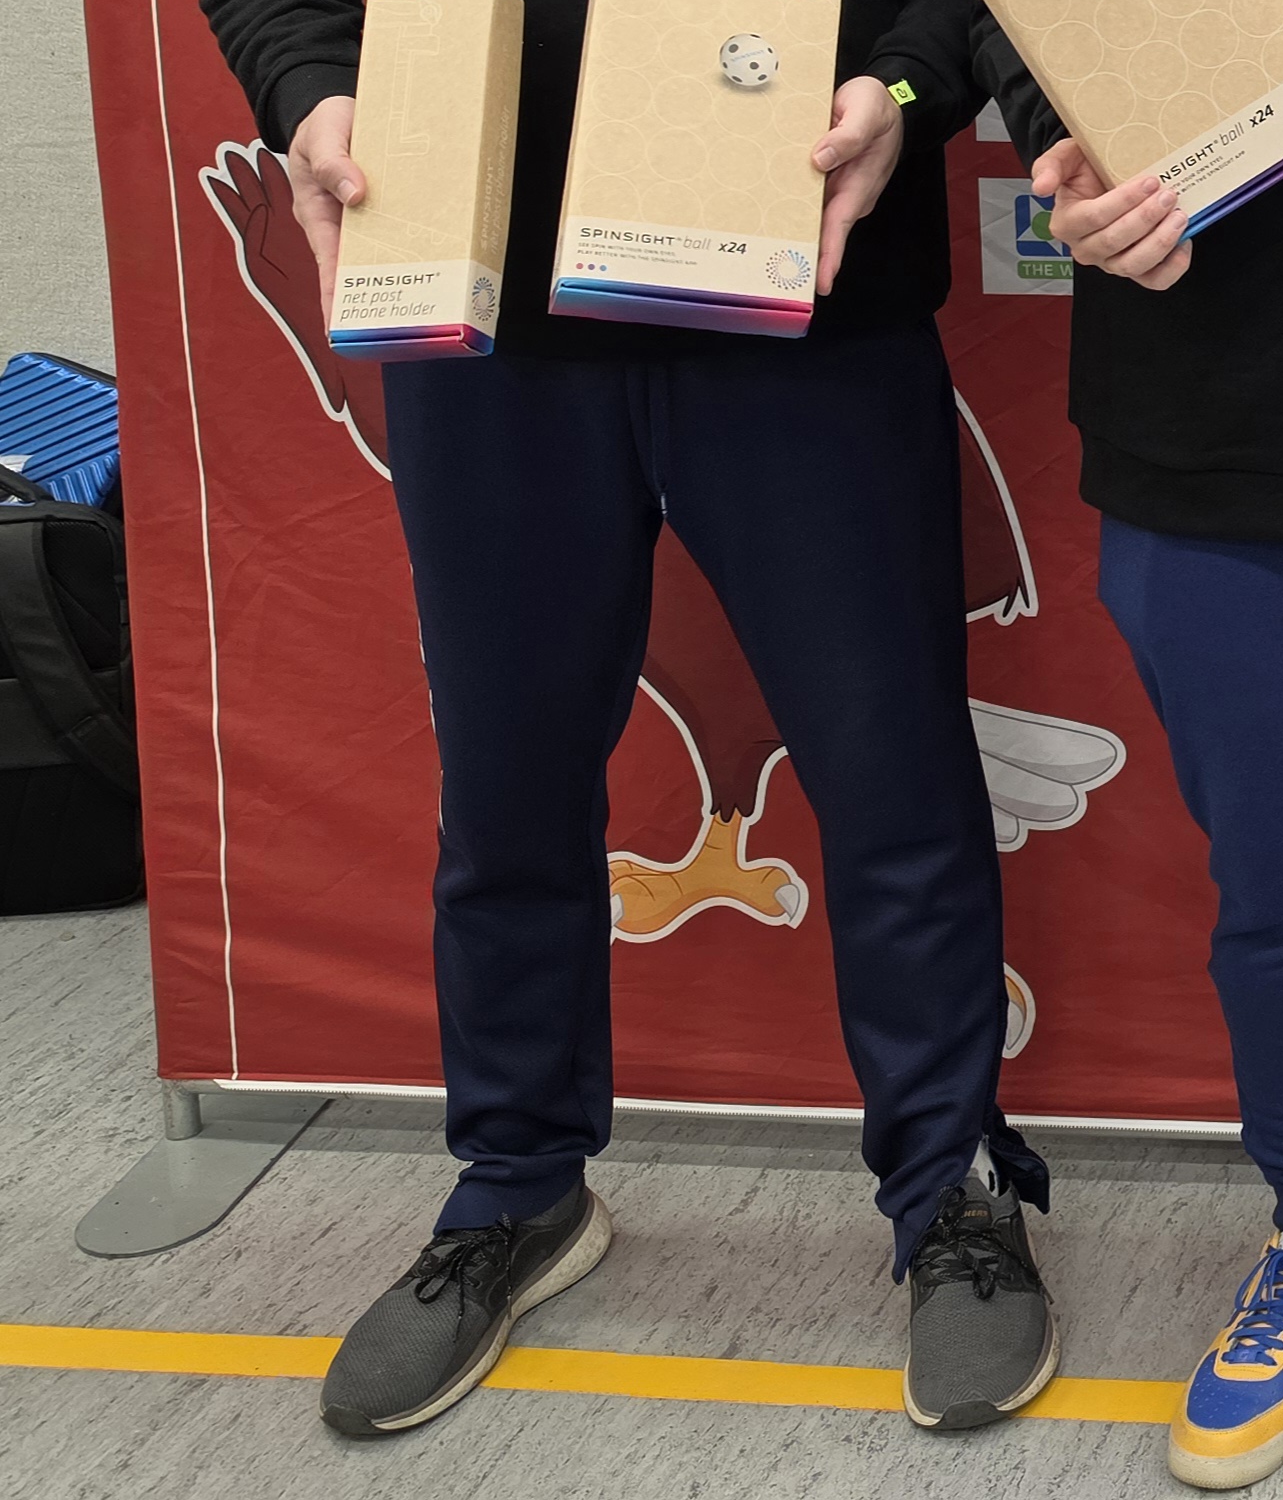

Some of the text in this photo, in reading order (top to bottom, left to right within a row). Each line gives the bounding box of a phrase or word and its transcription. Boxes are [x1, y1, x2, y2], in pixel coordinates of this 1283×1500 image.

[1159, 104, 1274, 184] NSIGHT® ball x24
[683, 236, 712, 250] ball
[718, 241, 747, 255] x24
[343, 289, 402, 306] net post
[340, 301, 436, 322] phone holder
